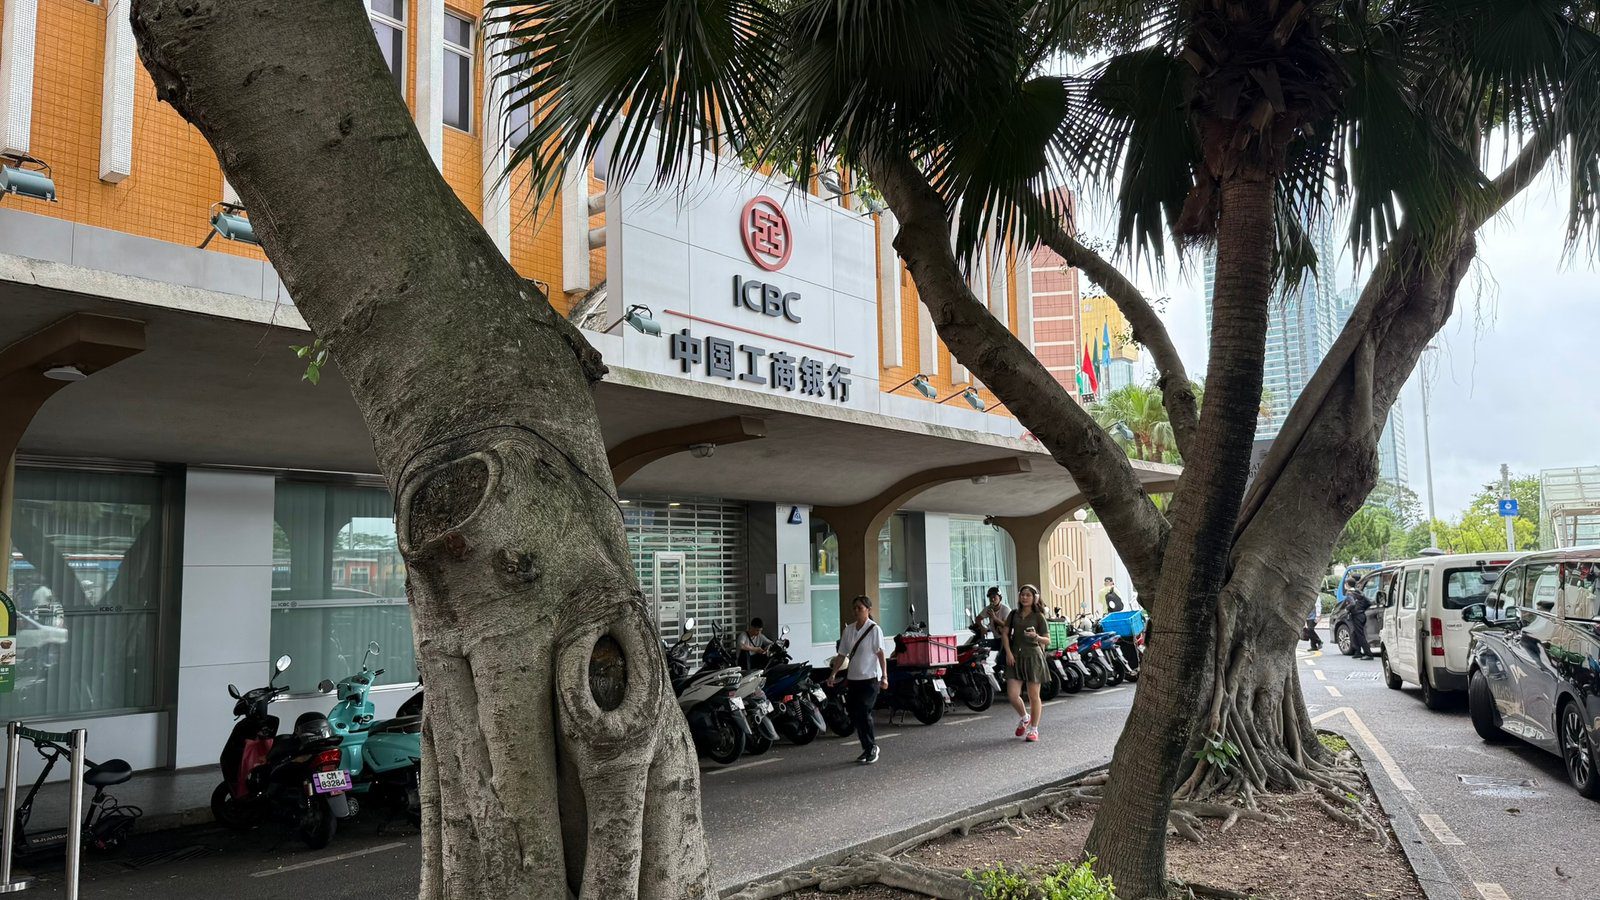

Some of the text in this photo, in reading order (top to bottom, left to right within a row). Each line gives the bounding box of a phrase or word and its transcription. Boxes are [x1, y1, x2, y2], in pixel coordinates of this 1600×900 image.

[733, 275, 801, 323] ICBC
[671, 329, 852, 402] 中国工商银行
[321, 779, 346, 788] 83284
[326, 772, 337, 780] CM
